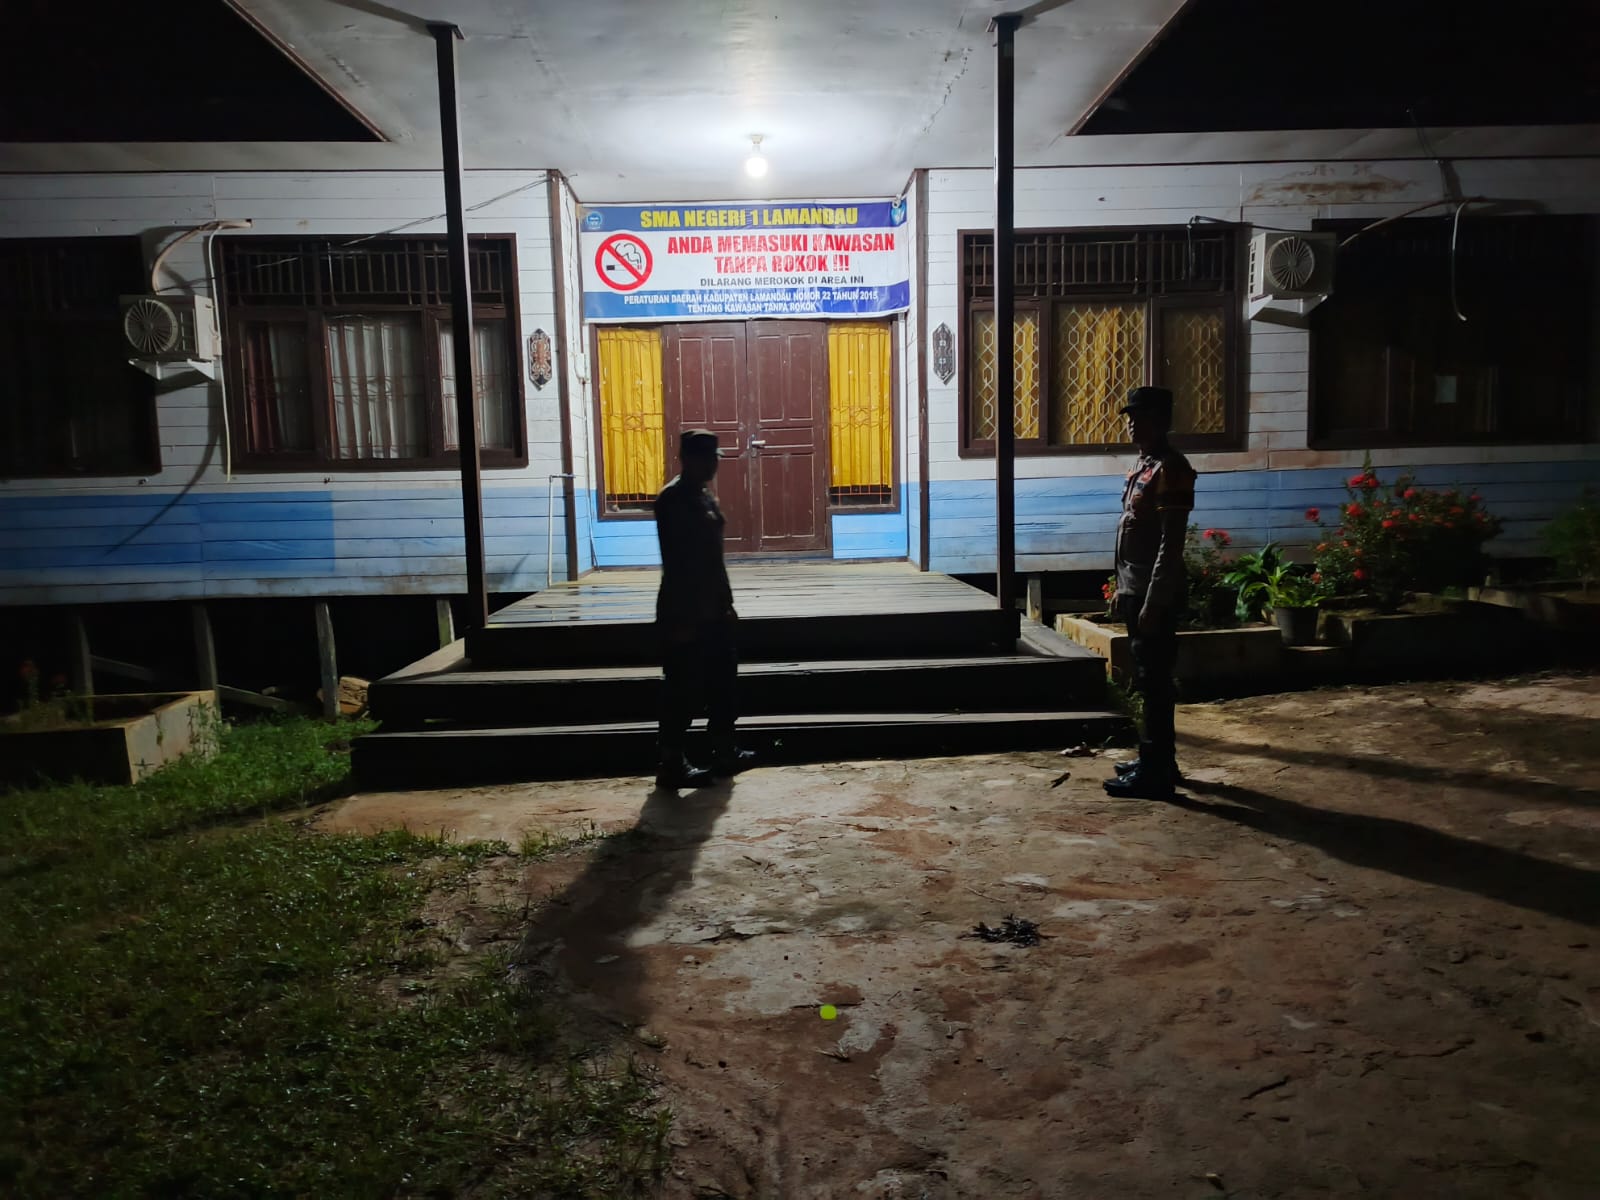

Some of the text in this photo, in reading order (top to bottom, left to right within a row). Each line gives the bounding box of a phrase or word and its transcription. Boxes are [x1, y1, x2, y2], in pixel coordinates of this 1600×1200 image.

[640, 207, 858, 228] SMA NEGERI 1 LAMANDAU
[667, 233, 895, 254] ANDA MEMASUKI KAWASAN
[714, 255, 768, 274] TANPA
[771, 254, 829, 272] ROKOK
[700, 275, 864, 287] DILARANG MEROKOK DI AREA INI
[624, 294, 670, 305] PERATURAN
[671, 293, 702, 304] DAERAH
[704, 292, 748, 303] KABUPATEN
[750, 291, 791, 302] LAMANDAU
[793, 290, 820, 301] NOMOR
[821, 290, 831, 300] 22
[832, 289, 859, 300] TAHUN
[687, 301, 817, 314] TENTANG KAWASAN TANPA ROKOK
